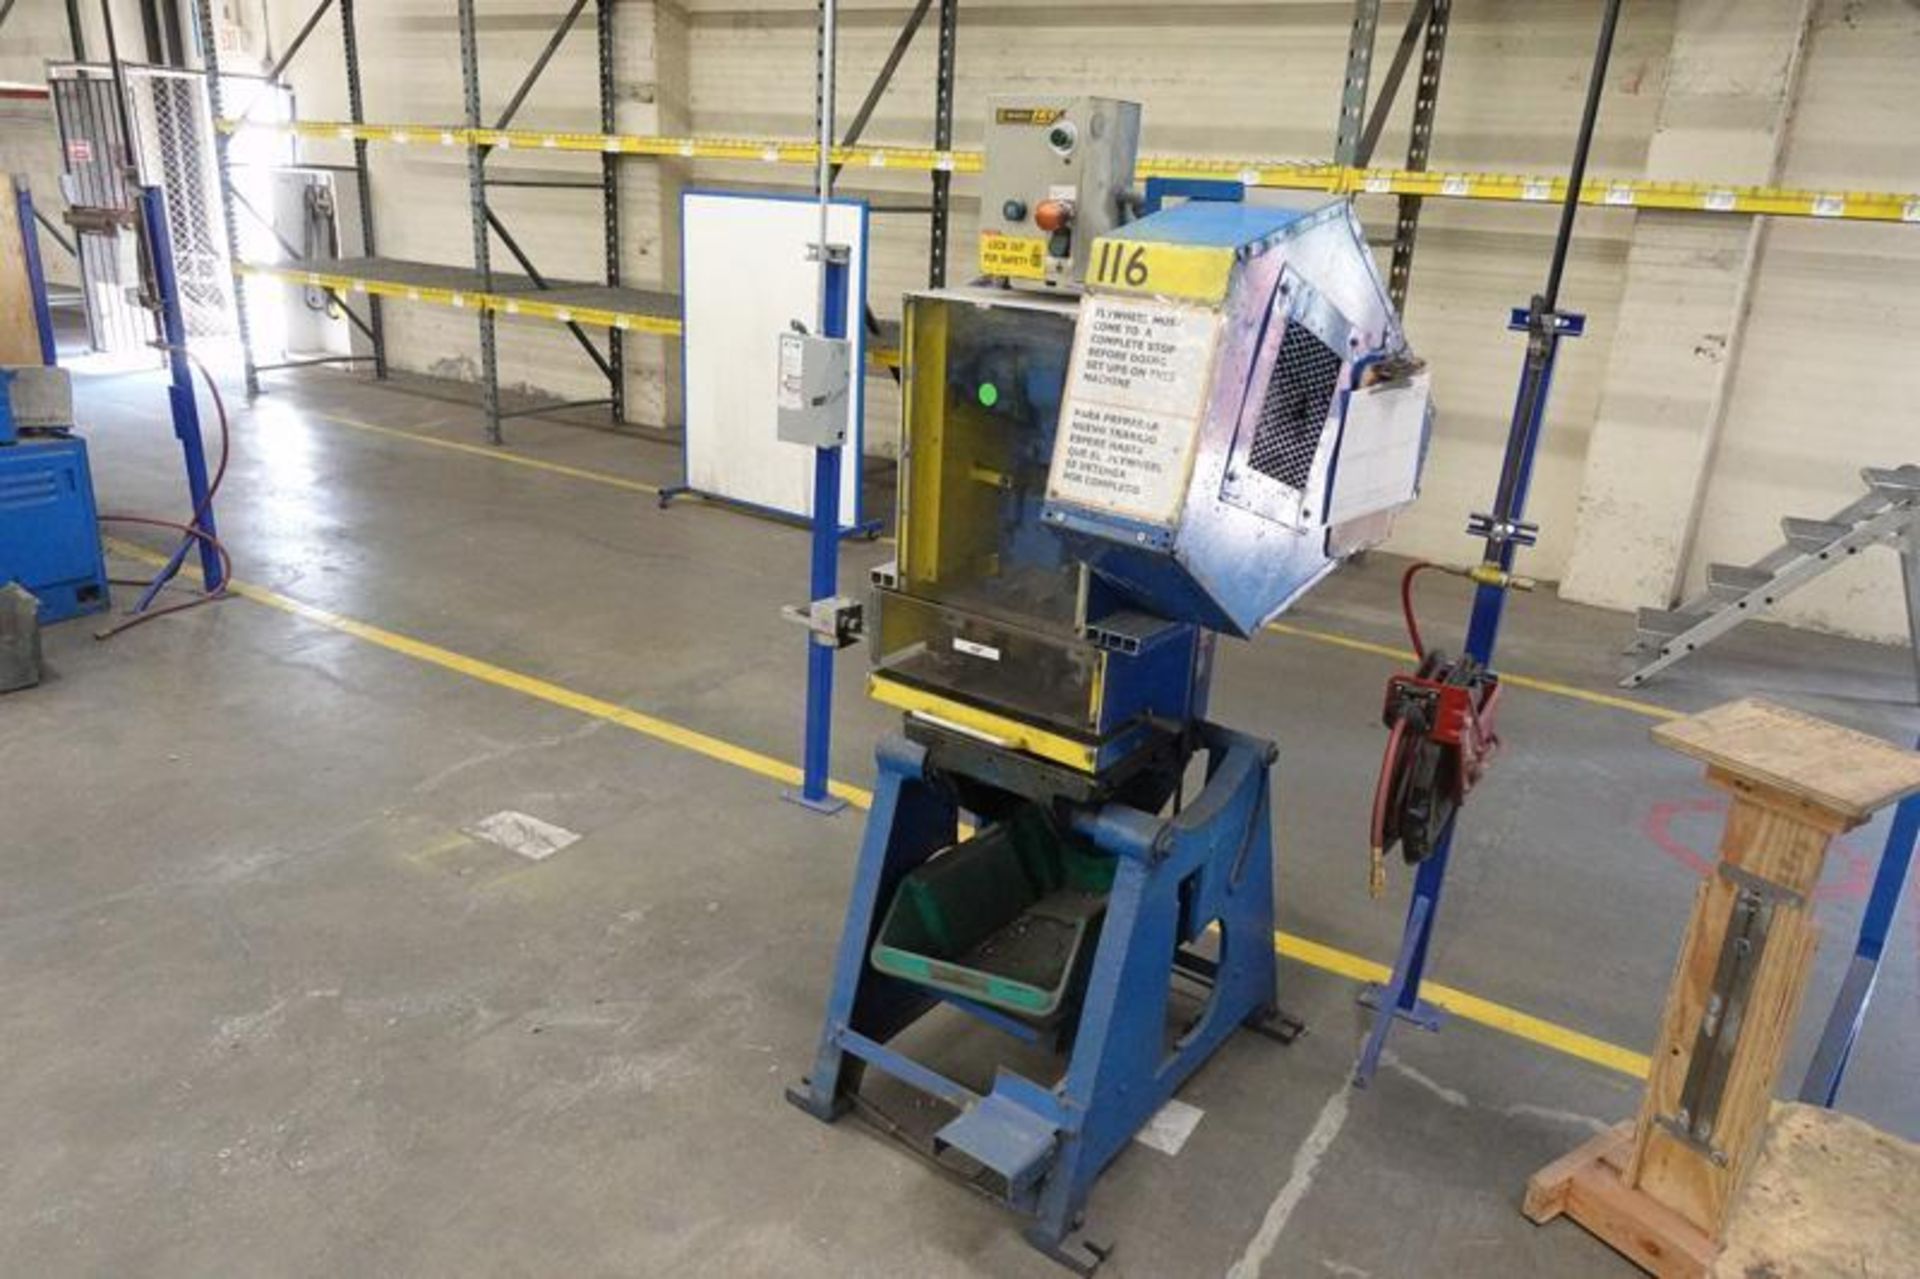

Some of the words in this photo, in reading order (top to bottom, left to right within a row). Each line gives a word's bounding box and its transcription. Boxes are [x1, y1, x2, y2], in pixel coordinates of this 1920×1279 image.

[988, 240, 1006, 250] LOCK
[984, 253, 998, 262] FOR
[1097, 242, 1148, 287] 116
[1093, 322, 1122, 334] COME
[1125, 326, 1139, 336] TO
[1144, 328, 1152, 337] A
[1091, 335, 1144, 351] COMPLETE
[1147, 342, 1177, 354] STOP
[1088, 348, 1126, 361] BEFORE
[1086, 360, 1105, 371] SET
[1107, 363, 1128, 375] UPS
[1130, 366, 1146, 377] ON
[1083, 374, 1131, 388] MACHINE
[1070, 434, 1106, 448] ESPERE
[1109, 440, 1143, 455] HASTA
[1068, 447, 1087, 458] QUE
[1089, 450, 1101, 461] EL
[1065, 460, 1078, 470] SE
